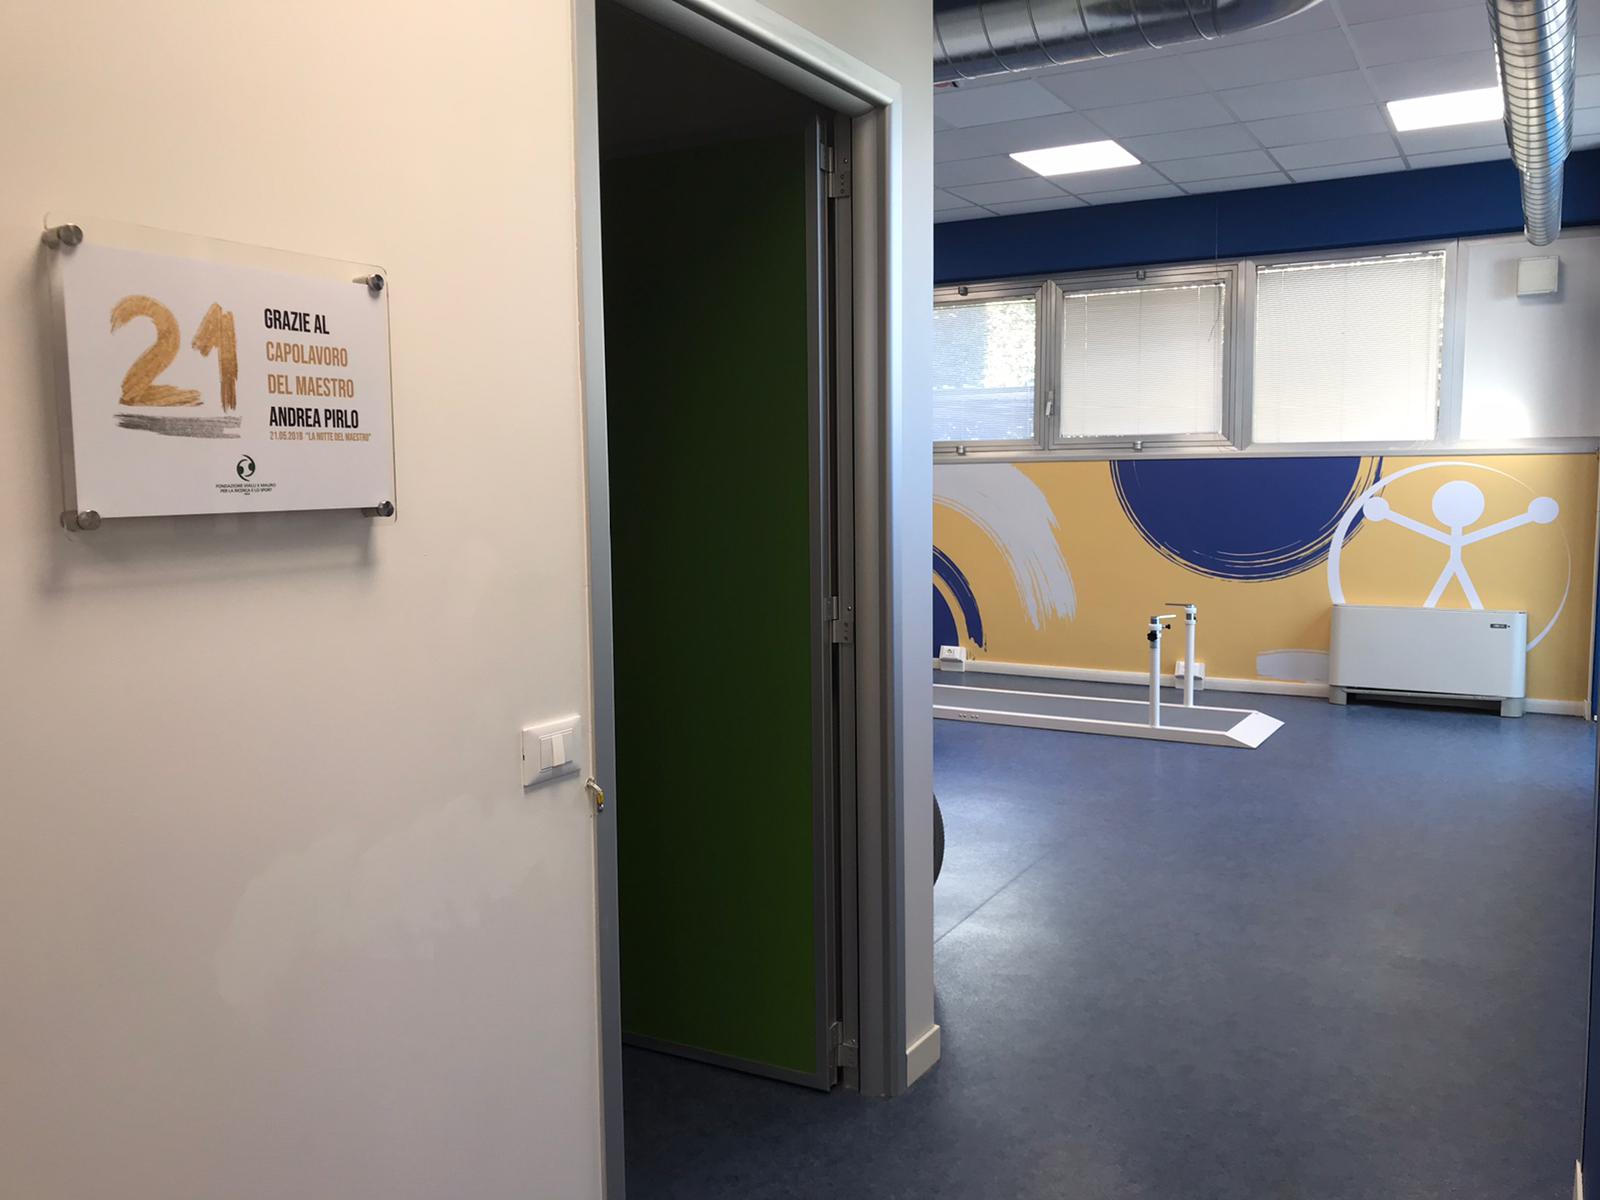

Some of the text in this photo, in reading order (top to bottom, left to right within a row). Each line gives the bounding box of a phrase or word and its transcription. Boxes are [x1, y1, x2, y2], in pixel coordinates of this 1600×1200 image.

[264, 308, 330, 335] GRAZIE AL
[109, 294, 239, 413] 21
[266, 341, 348, 367] CAPOLAVORO
[267, 374, 354, 398] DEL MAESTRO
[269, 406, 359, 429] ANDREA PIRLO
[316, 432, 333, 441] NOTTE
[334, 433, 344, 441] DEL
